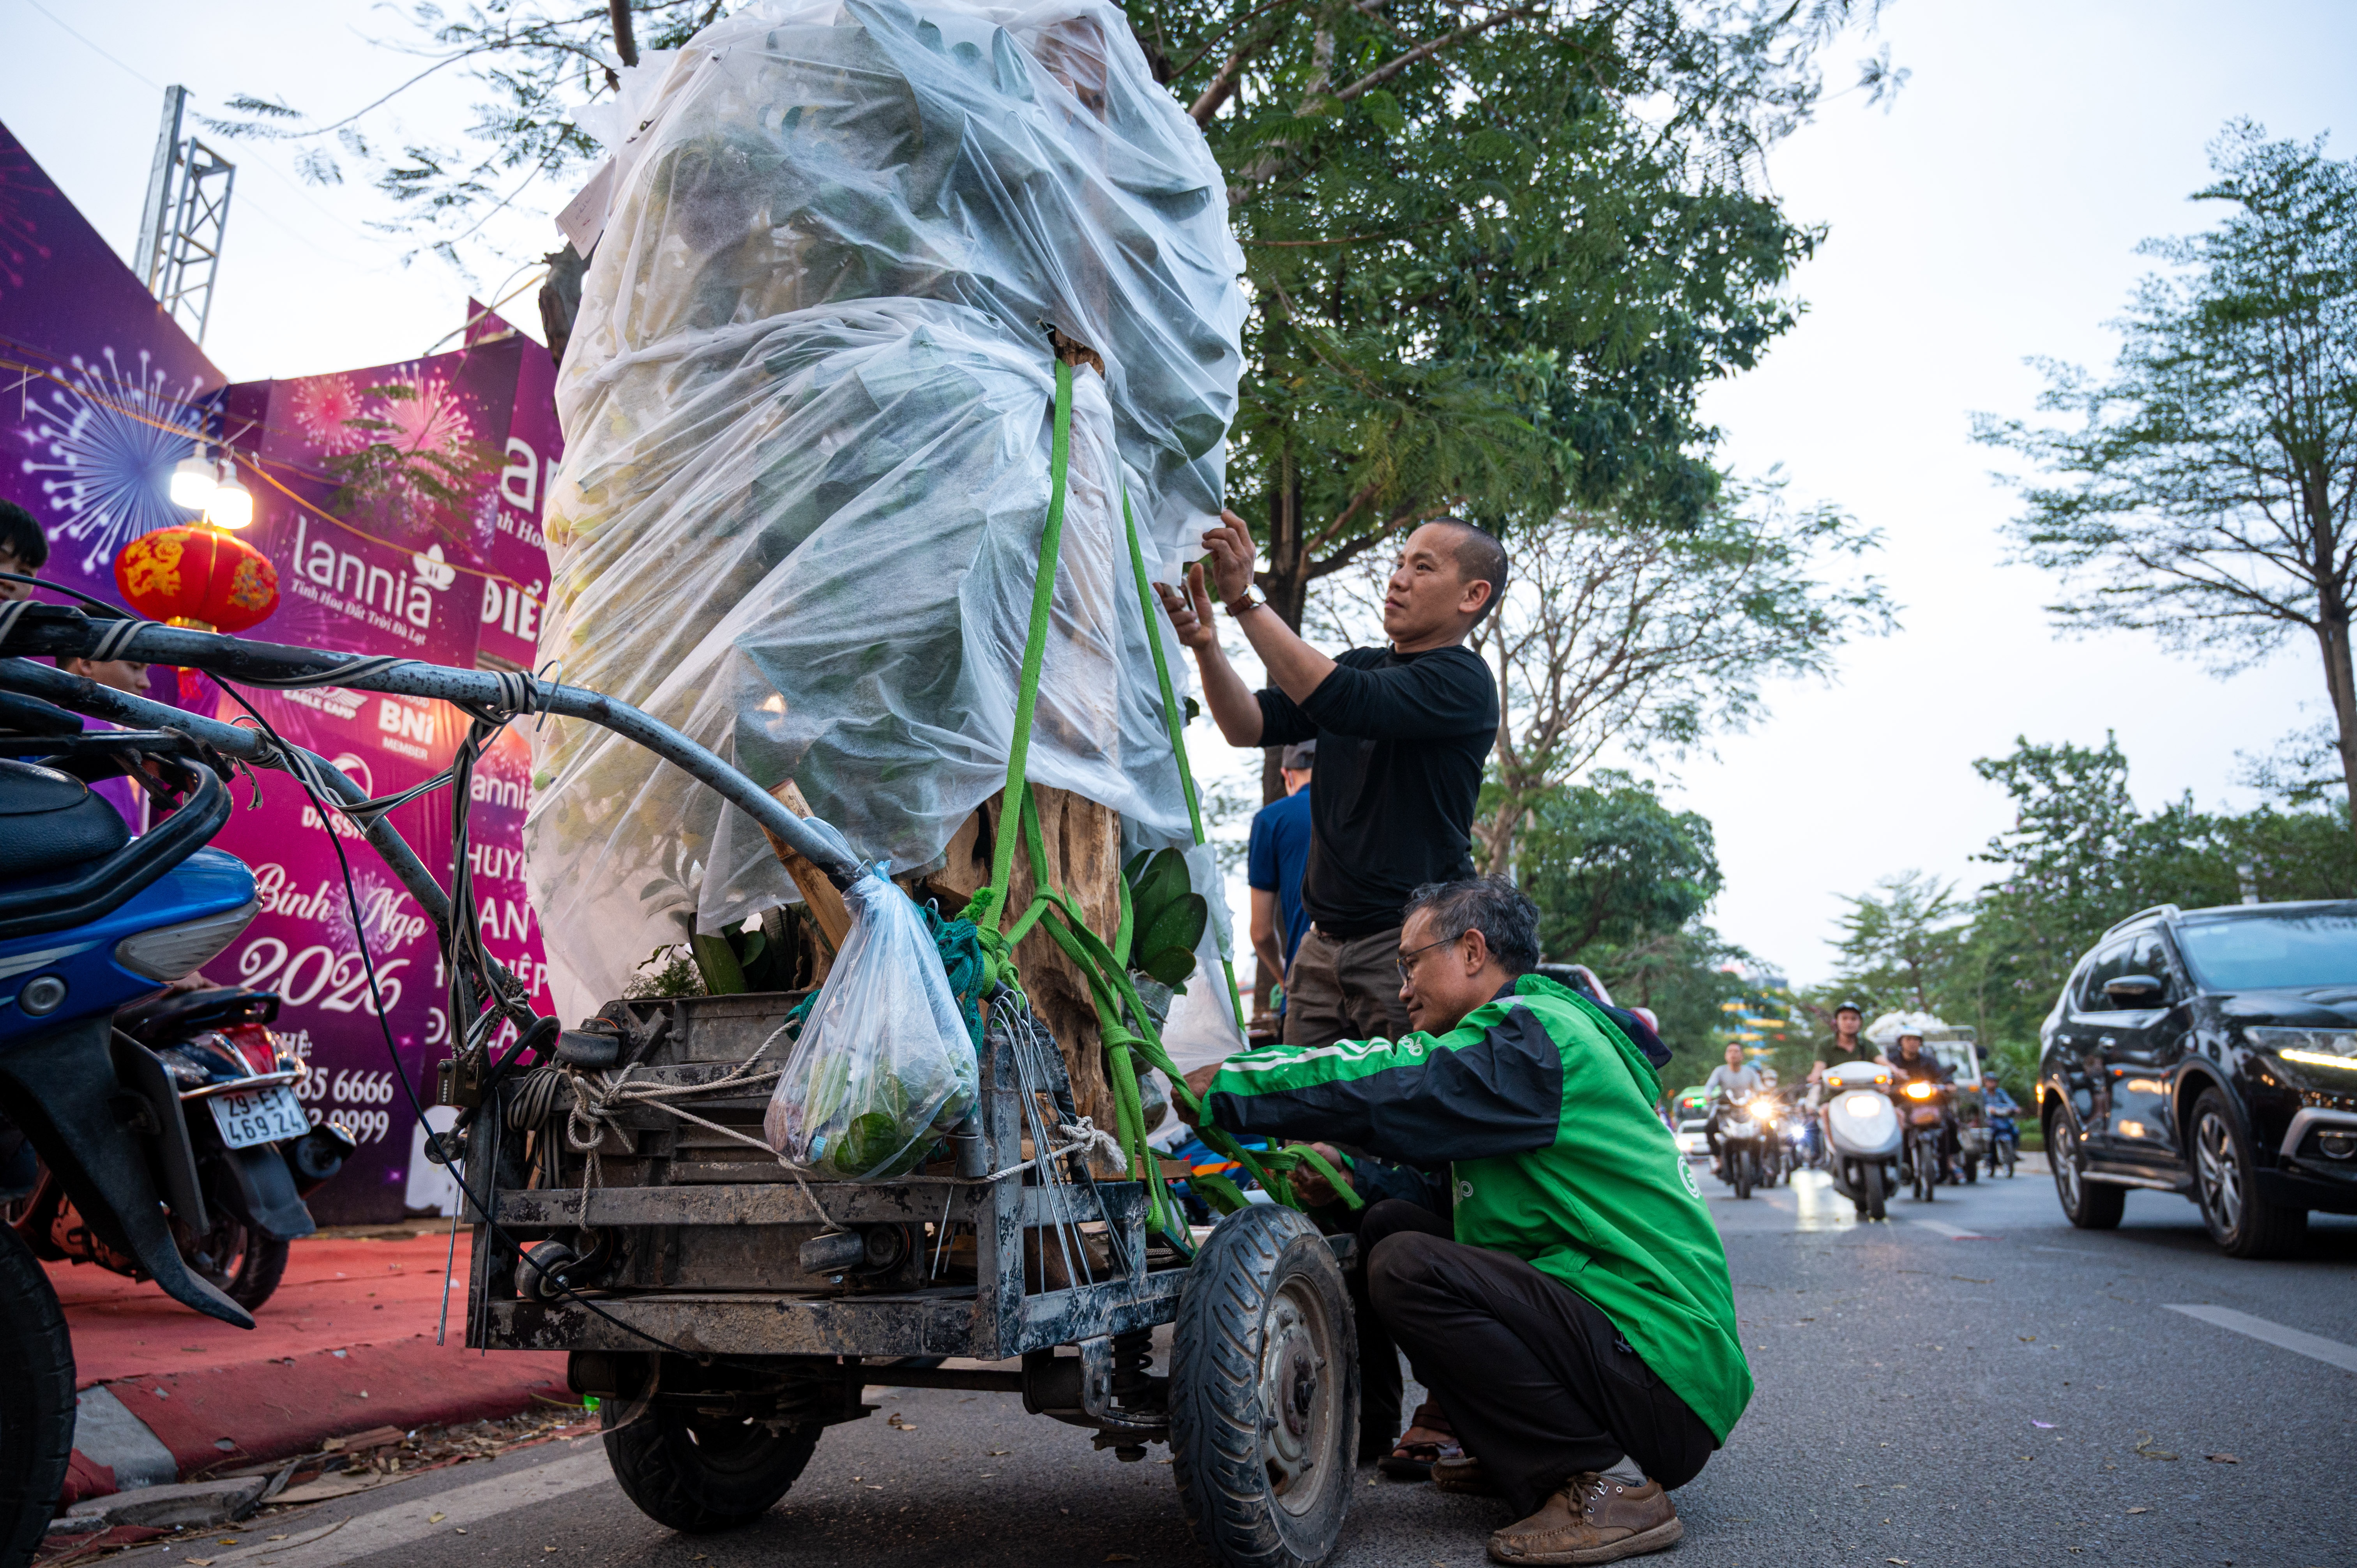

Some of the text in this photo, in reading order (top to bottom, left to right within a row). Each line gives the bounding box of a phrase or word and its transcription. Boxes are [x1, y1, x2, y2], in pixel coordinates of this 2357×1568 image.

[293, 514, 433, 629] lannia
[292, 577, 319, 602] Tinh
[319, 590, 344, 611] Hoa
[322, 701, 357, 721] CAMP
[382, 736, 429, 761] MEMBER
[239, 936, 411, 1017] 2026
[223, 1088, 284, 1117] 29-E1
[333, 1068, 394, 1104] 6666
[228, 1109, 302, 1142] 469.24
